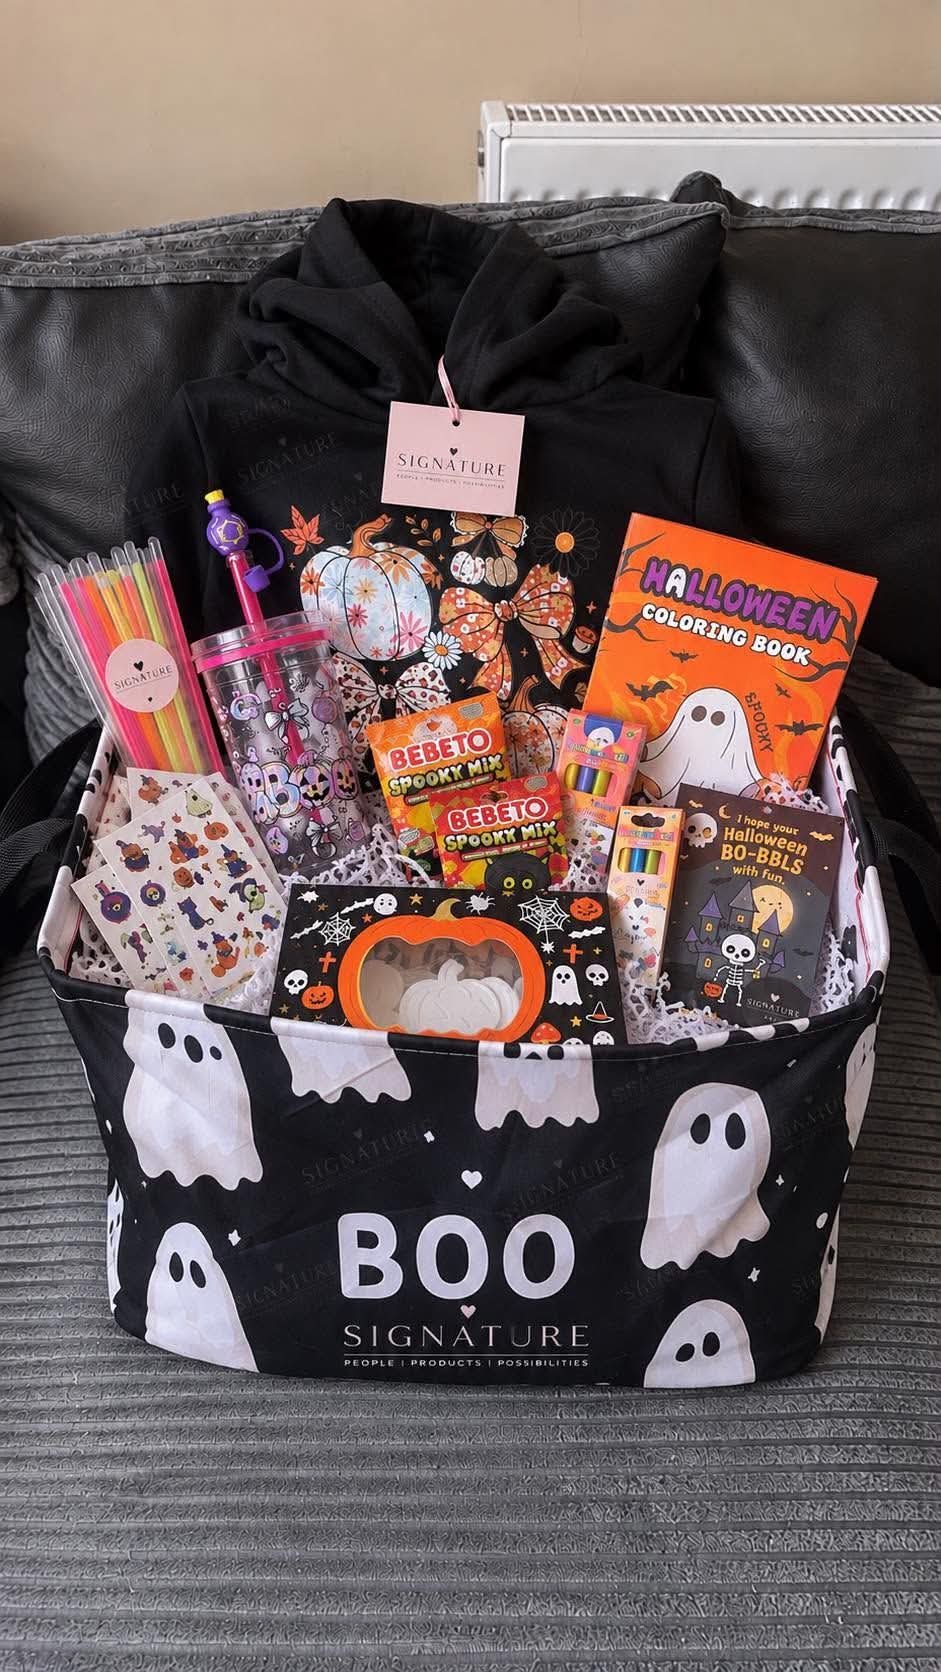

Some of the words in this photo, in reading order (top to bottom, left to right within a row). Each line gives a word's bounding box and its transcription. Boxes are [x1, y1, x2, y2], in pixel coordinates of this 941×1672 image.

[397, 453, 507, 477] SIGNATURE
[641, 557, 839, 644] HALLOWEEN
[641, 603, 748, 646] COLORING
[750, 635, 811, 666] BOOK
[114, 665, 173, 690] SIGNATURE
[389, 728, 491, 771] BEBETO
[448, 797, 548, 831] BEBETO
[736, 814, 742, 823] I
[744, 815, 770, 829] hope
[773, 823, 799, 835] your
[724, 827, 808, 857] Halloween
[721, 843, 804, 875] BO-BBLS
[732, 865, 758, 877] with
[762, 869, 785, 885] fun.
[747, 998, 800, 1018] SIGNATURE
[338, 1212, 575, 1300] BOO
[343, 1324, 590, 1347] SIGNATURE
[344, 1359, 395, 1367] PEOPLE
[411, 1359, 482, 1367] PRODUCTS
[497, 1359, 589, 1367] POSSIBILITIES
